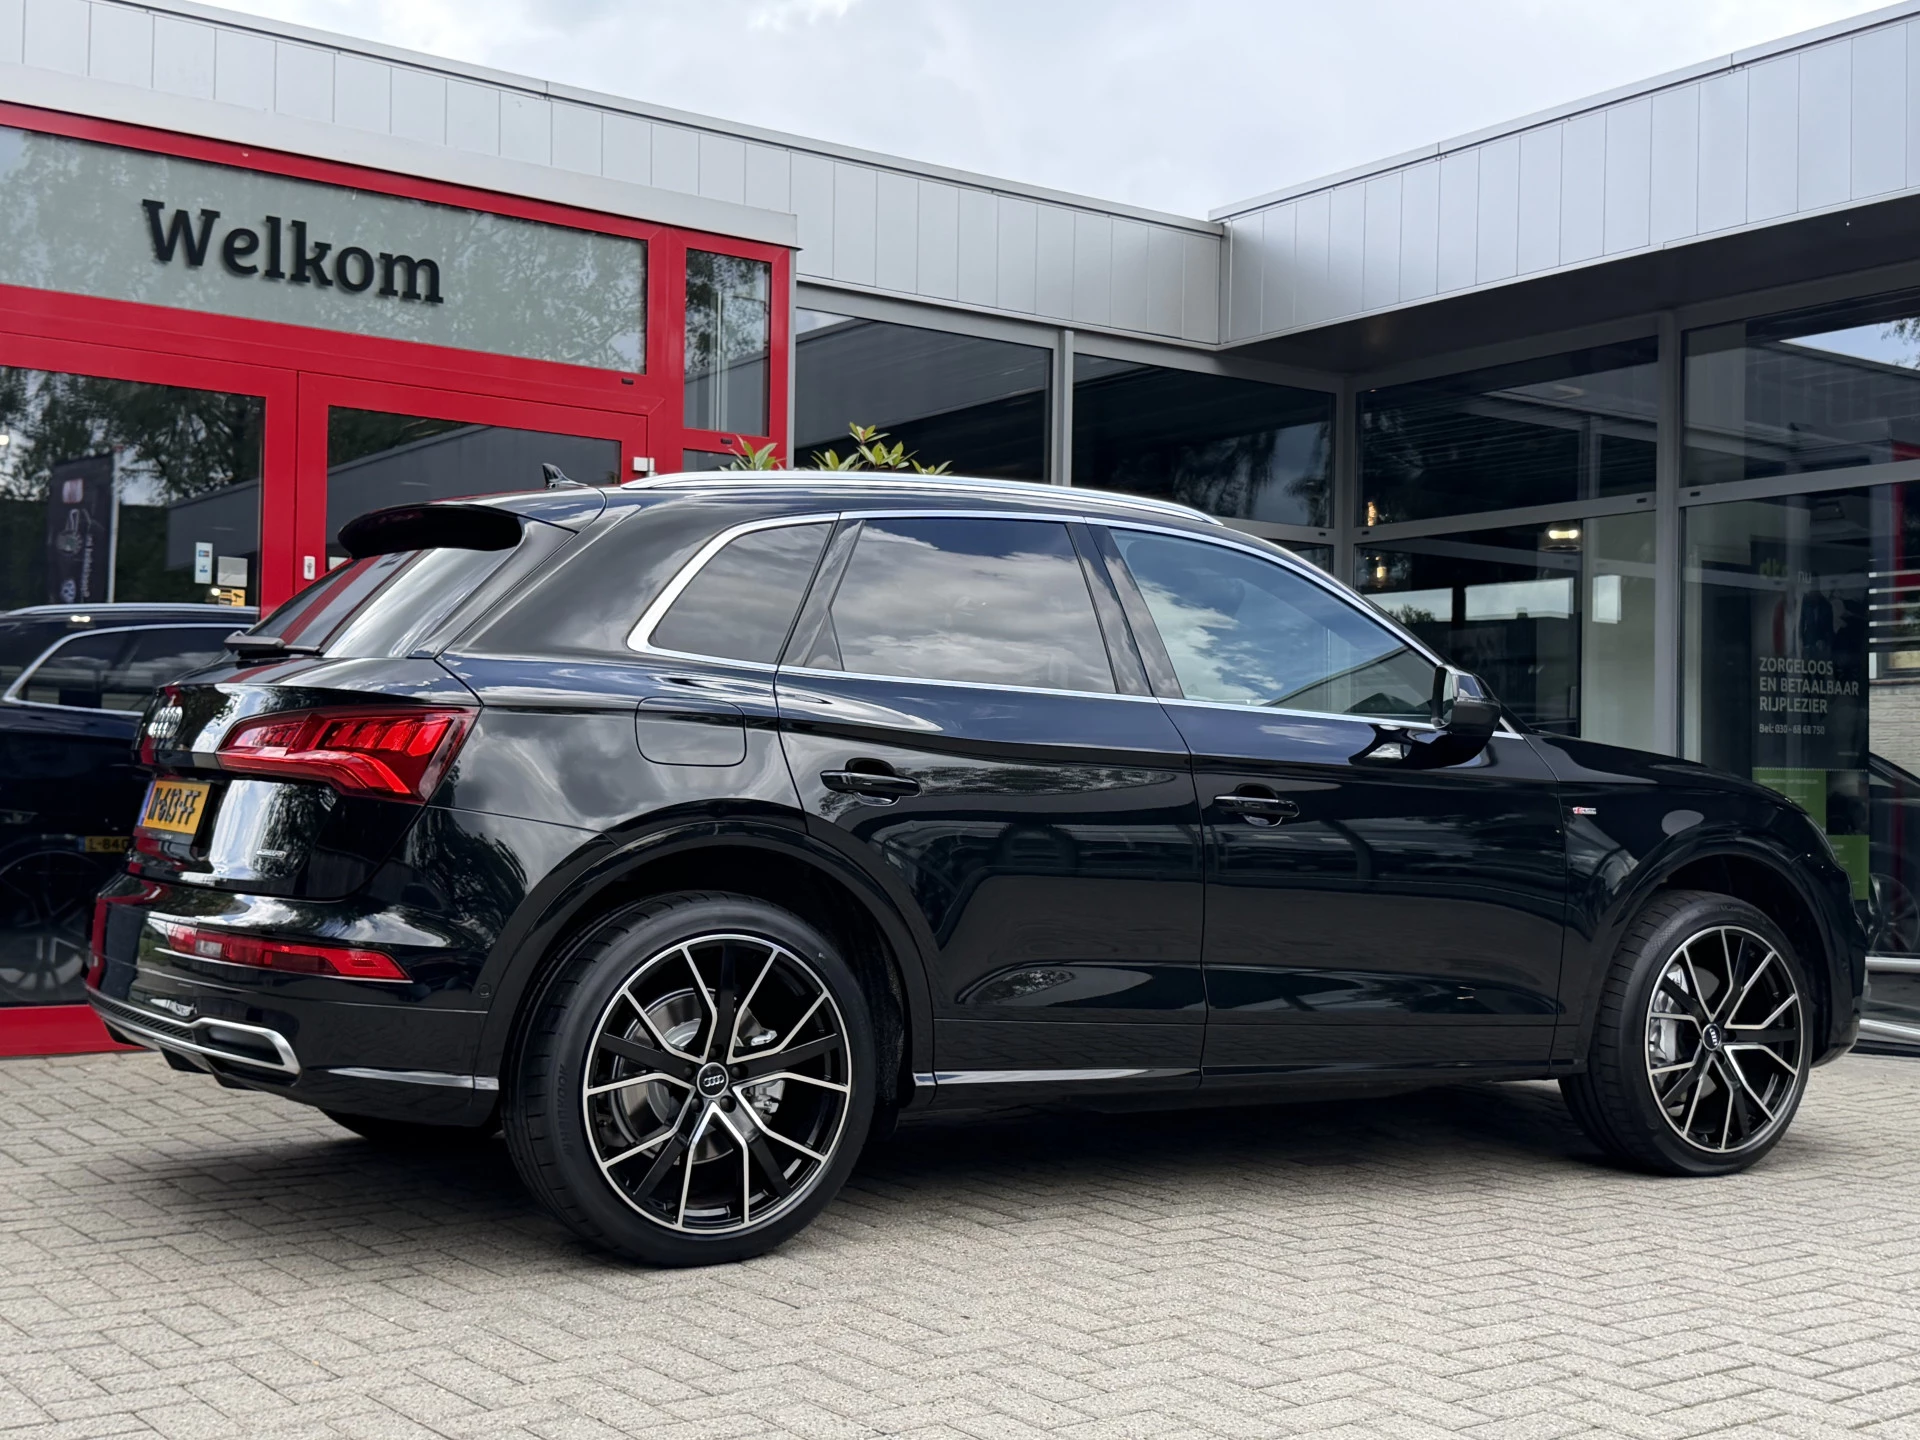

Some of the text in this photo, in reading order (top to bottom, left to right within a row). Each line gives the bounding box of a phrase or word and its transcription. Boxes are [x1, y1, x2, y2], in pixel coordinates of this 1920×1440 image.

[142, 198, 444, 304] Welkom
[1759, 656, 1833, 675] ZORGELOOS
[1760, 677, 1859, 695] EN BETAALBAAR
[1760, 696, 1828, 713] RIJPLEZIER
